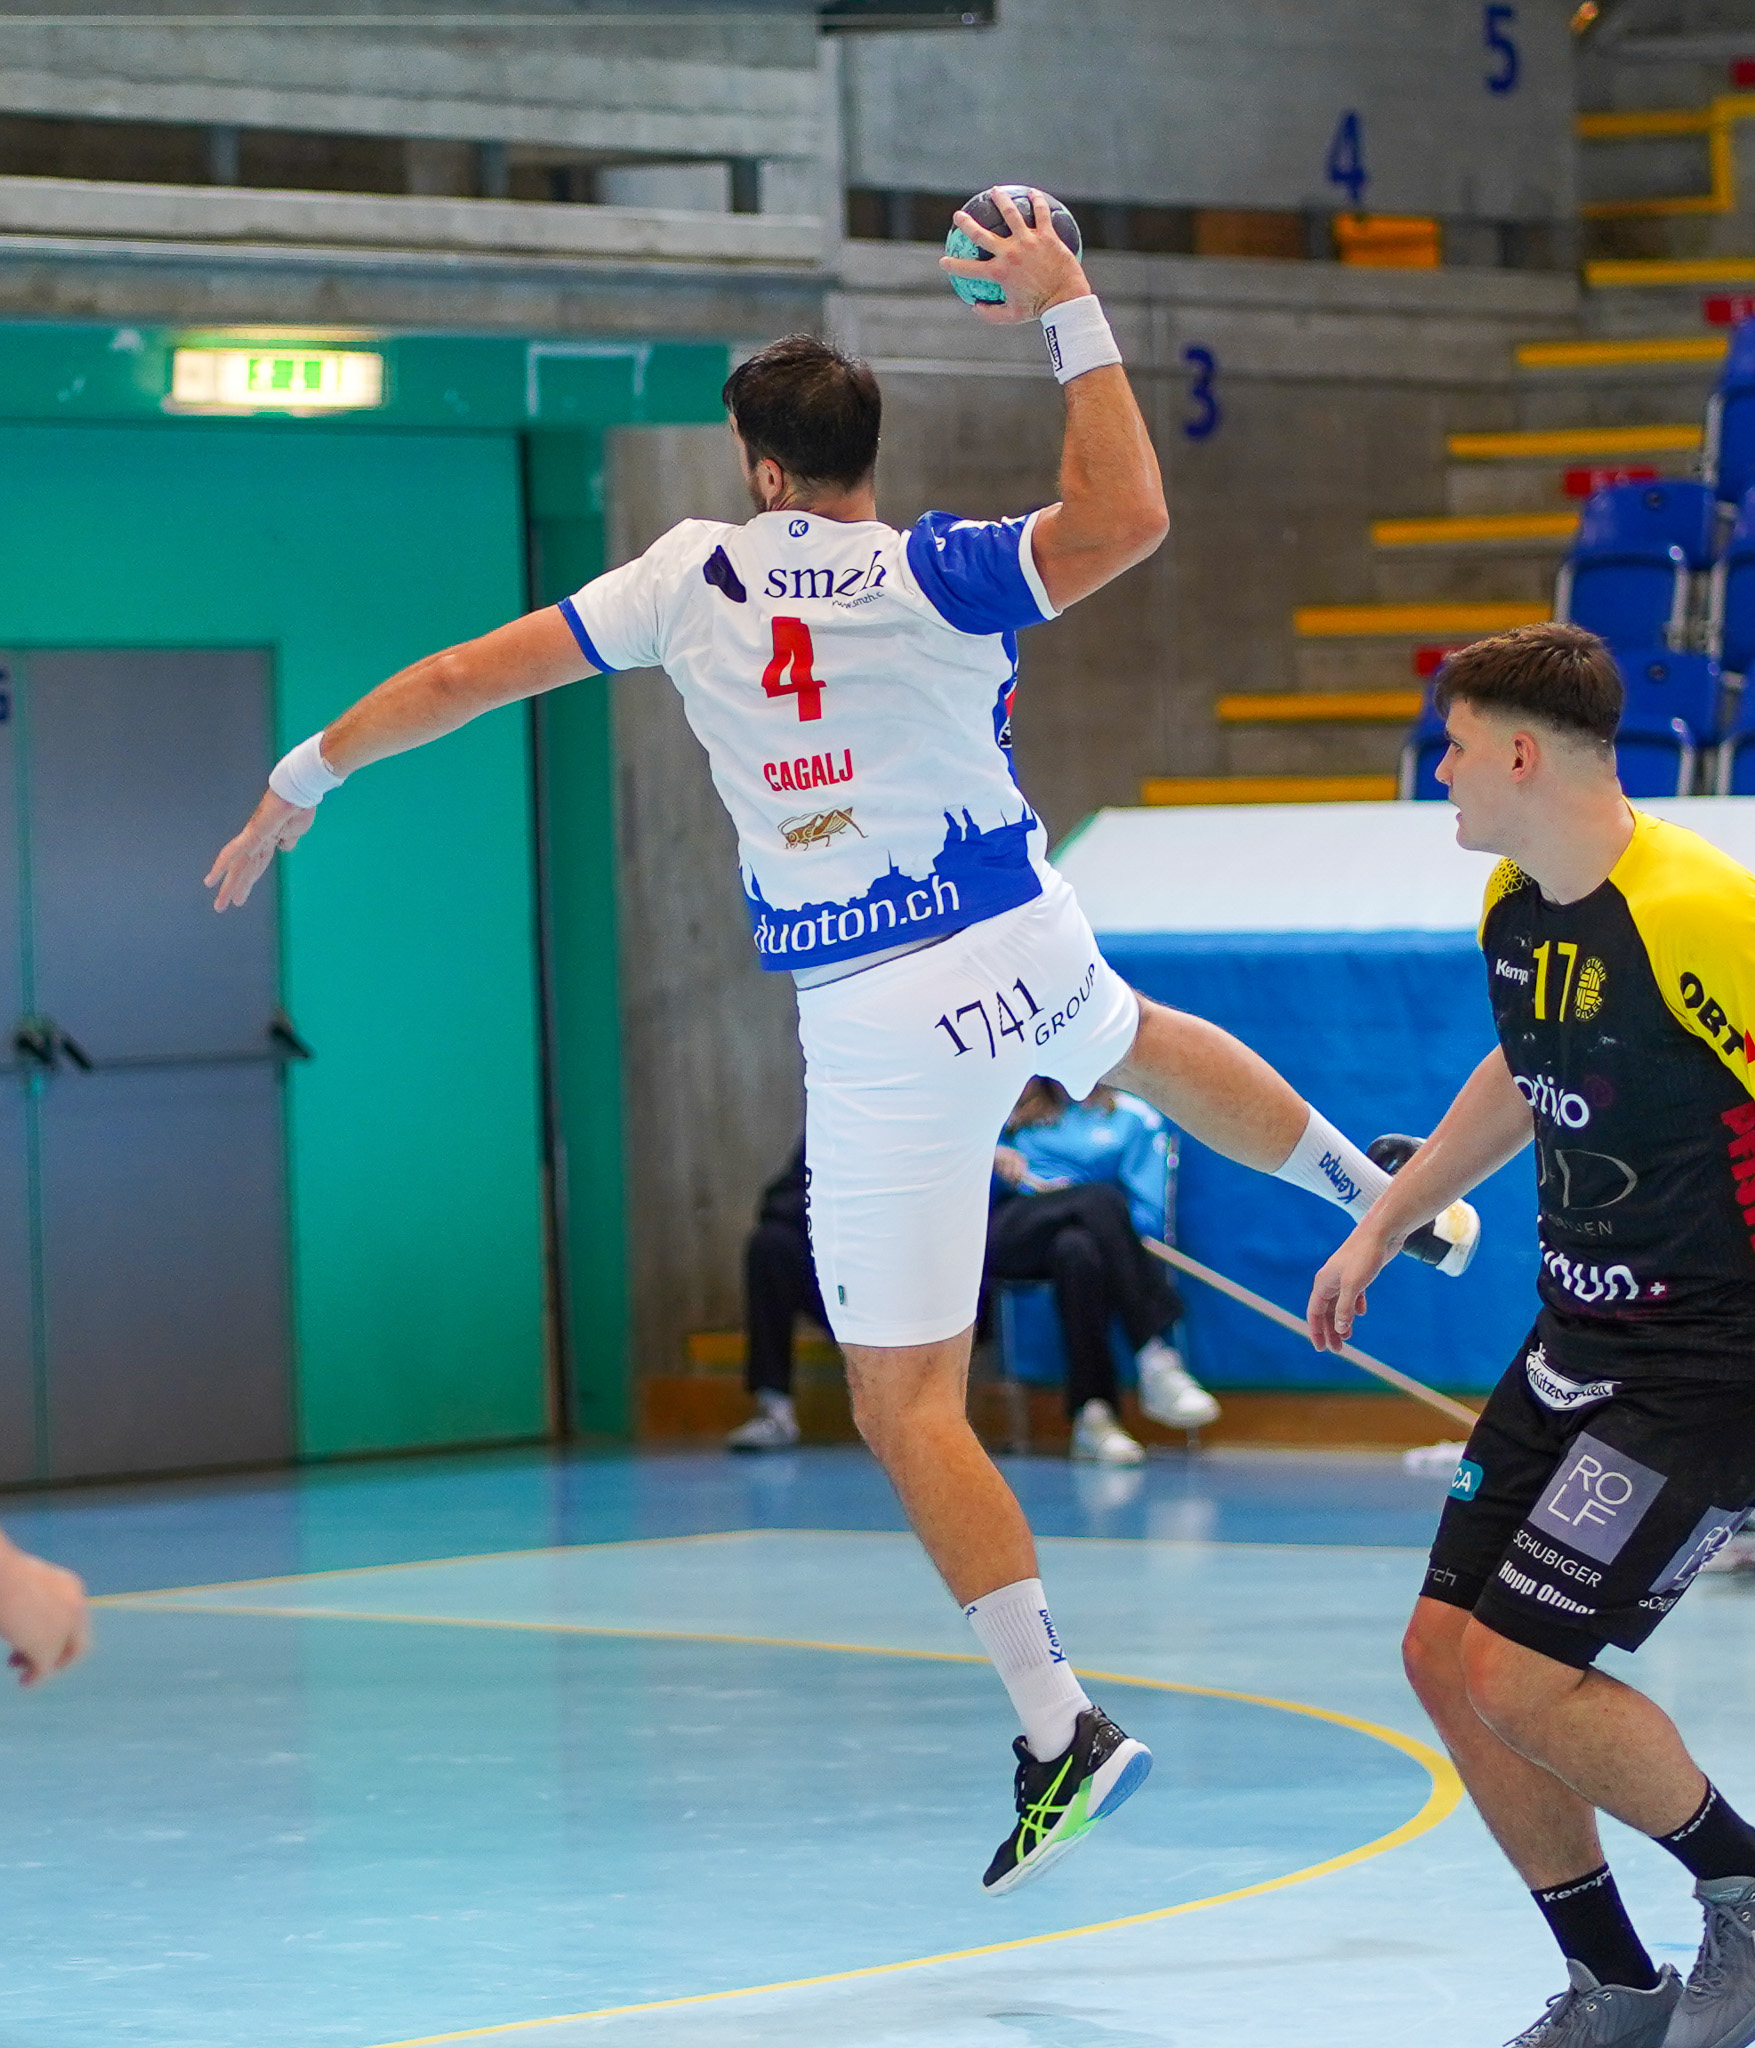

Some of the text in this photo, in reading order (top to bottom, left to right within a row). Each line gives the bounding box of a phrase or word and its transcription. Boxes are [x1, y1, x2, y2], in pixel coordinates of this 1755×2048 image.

[1484, 4, 1521, 95] 5
[1327, 108, 1367, 206] 4
[1183, 346, 1222, 441] 3
[763, 549, 887, 599] smzh
[761, 616, 827, 722] 4
[763, 748, 854, 792] CAGALJ
[753, 874, 961, 955] duoton.ch
[934, 977, 1045, 1060] 1741
[1034, 963, 1095, 1046] GROUP
[1532, 940, 1578, 1023] 17
[1318, 1150, 1362, 1204] Kempa
[1547, 1484, 1617, 1526] LF
[1567, 1454, 1633, 1505] RO
[1498, 1560, 1537, 1595] Hopp
[1512, 1529, 1603, 1588] SCHUBIGER
